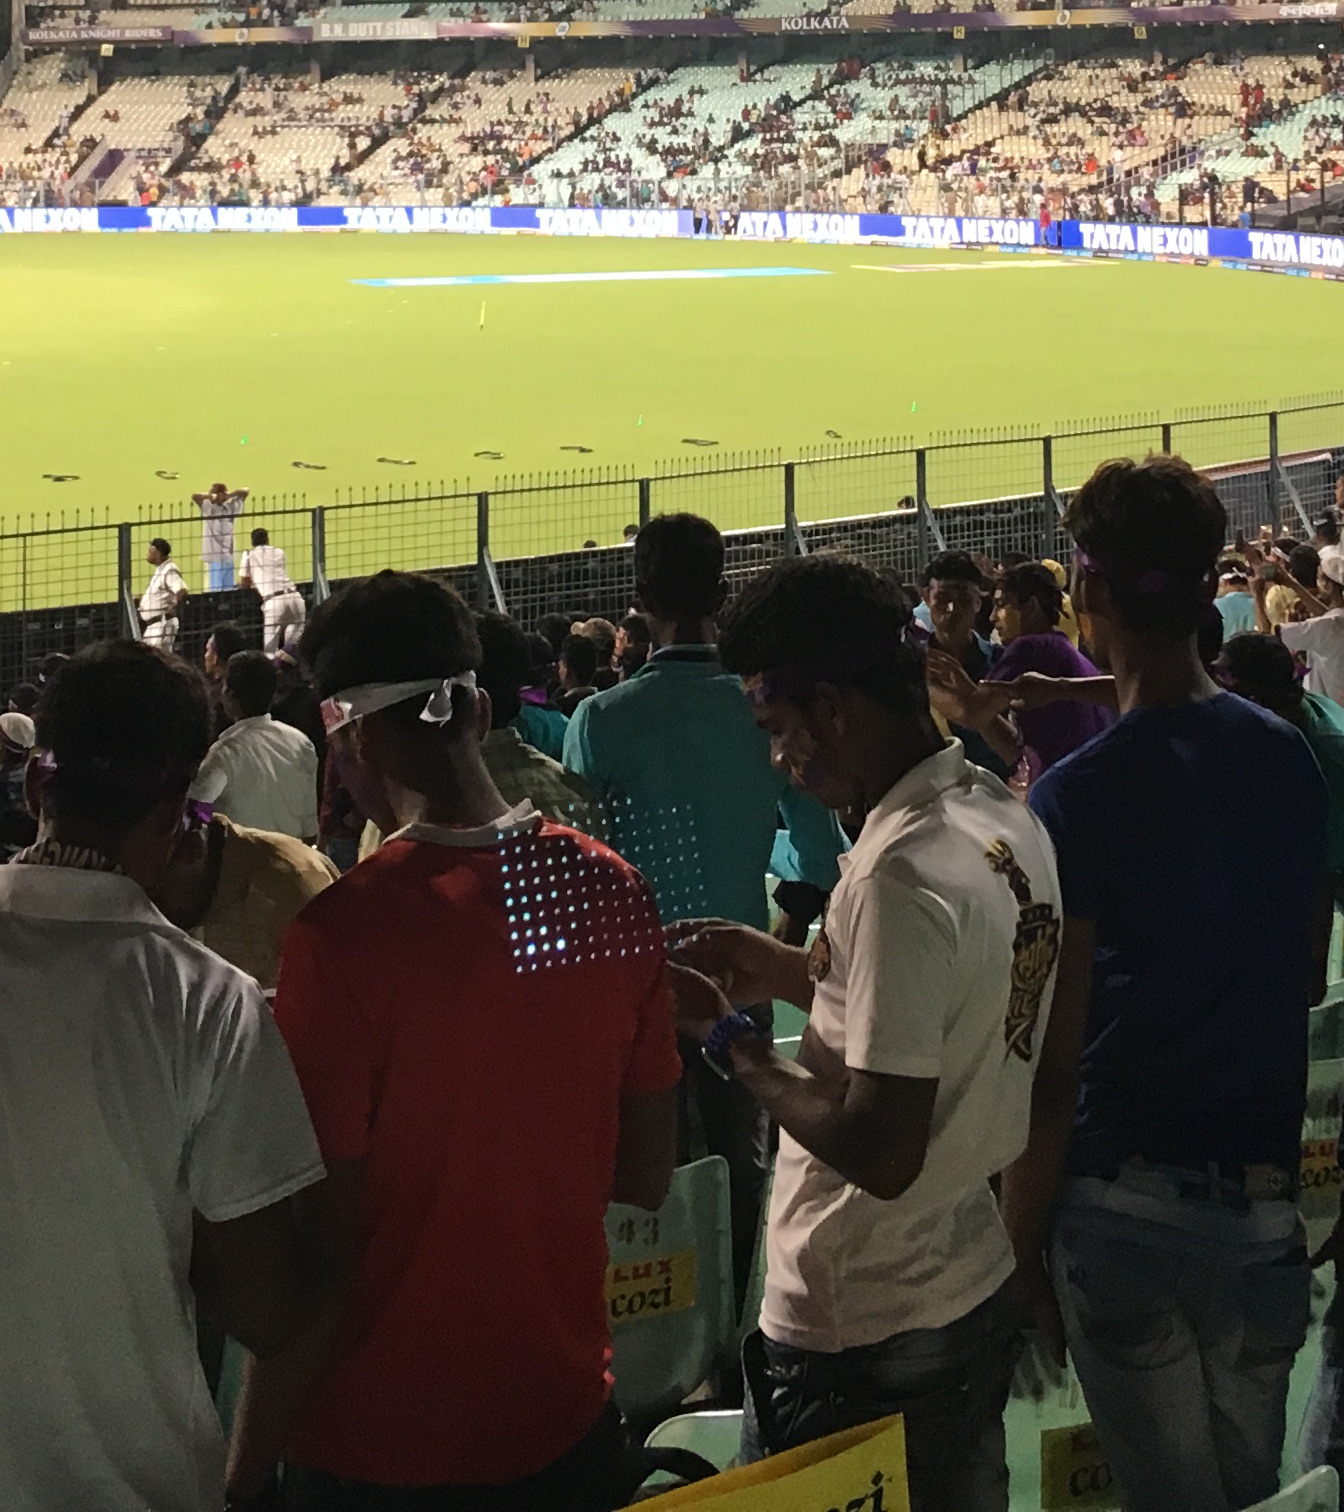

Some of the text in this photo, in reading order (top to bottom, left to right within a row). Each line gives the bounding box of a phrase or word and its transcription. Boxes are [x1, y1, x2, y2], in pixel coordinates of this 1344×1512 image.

[28, 27, 163, 41] KOLKATA KNIGHT RIDERS
[781, 16, 850, 31] KOLKATA
[147, 207, 216, 230] TATA
[343, 207, 409, 229] TATA
[536, 209, 601, 235] TATA
[901, 215, 1035, 245] TATA NEXON
[1079, 223, 1208, 256] TATA NEXON
[1248, 232, 1299, 262] TATA
[1304, 1141, 1337, 1159] LU
[1302, 1166, 1343, 1188] coz
[613, 1258, 672, 1284] LUX
[611, 1276, 675, 1318] cozi
